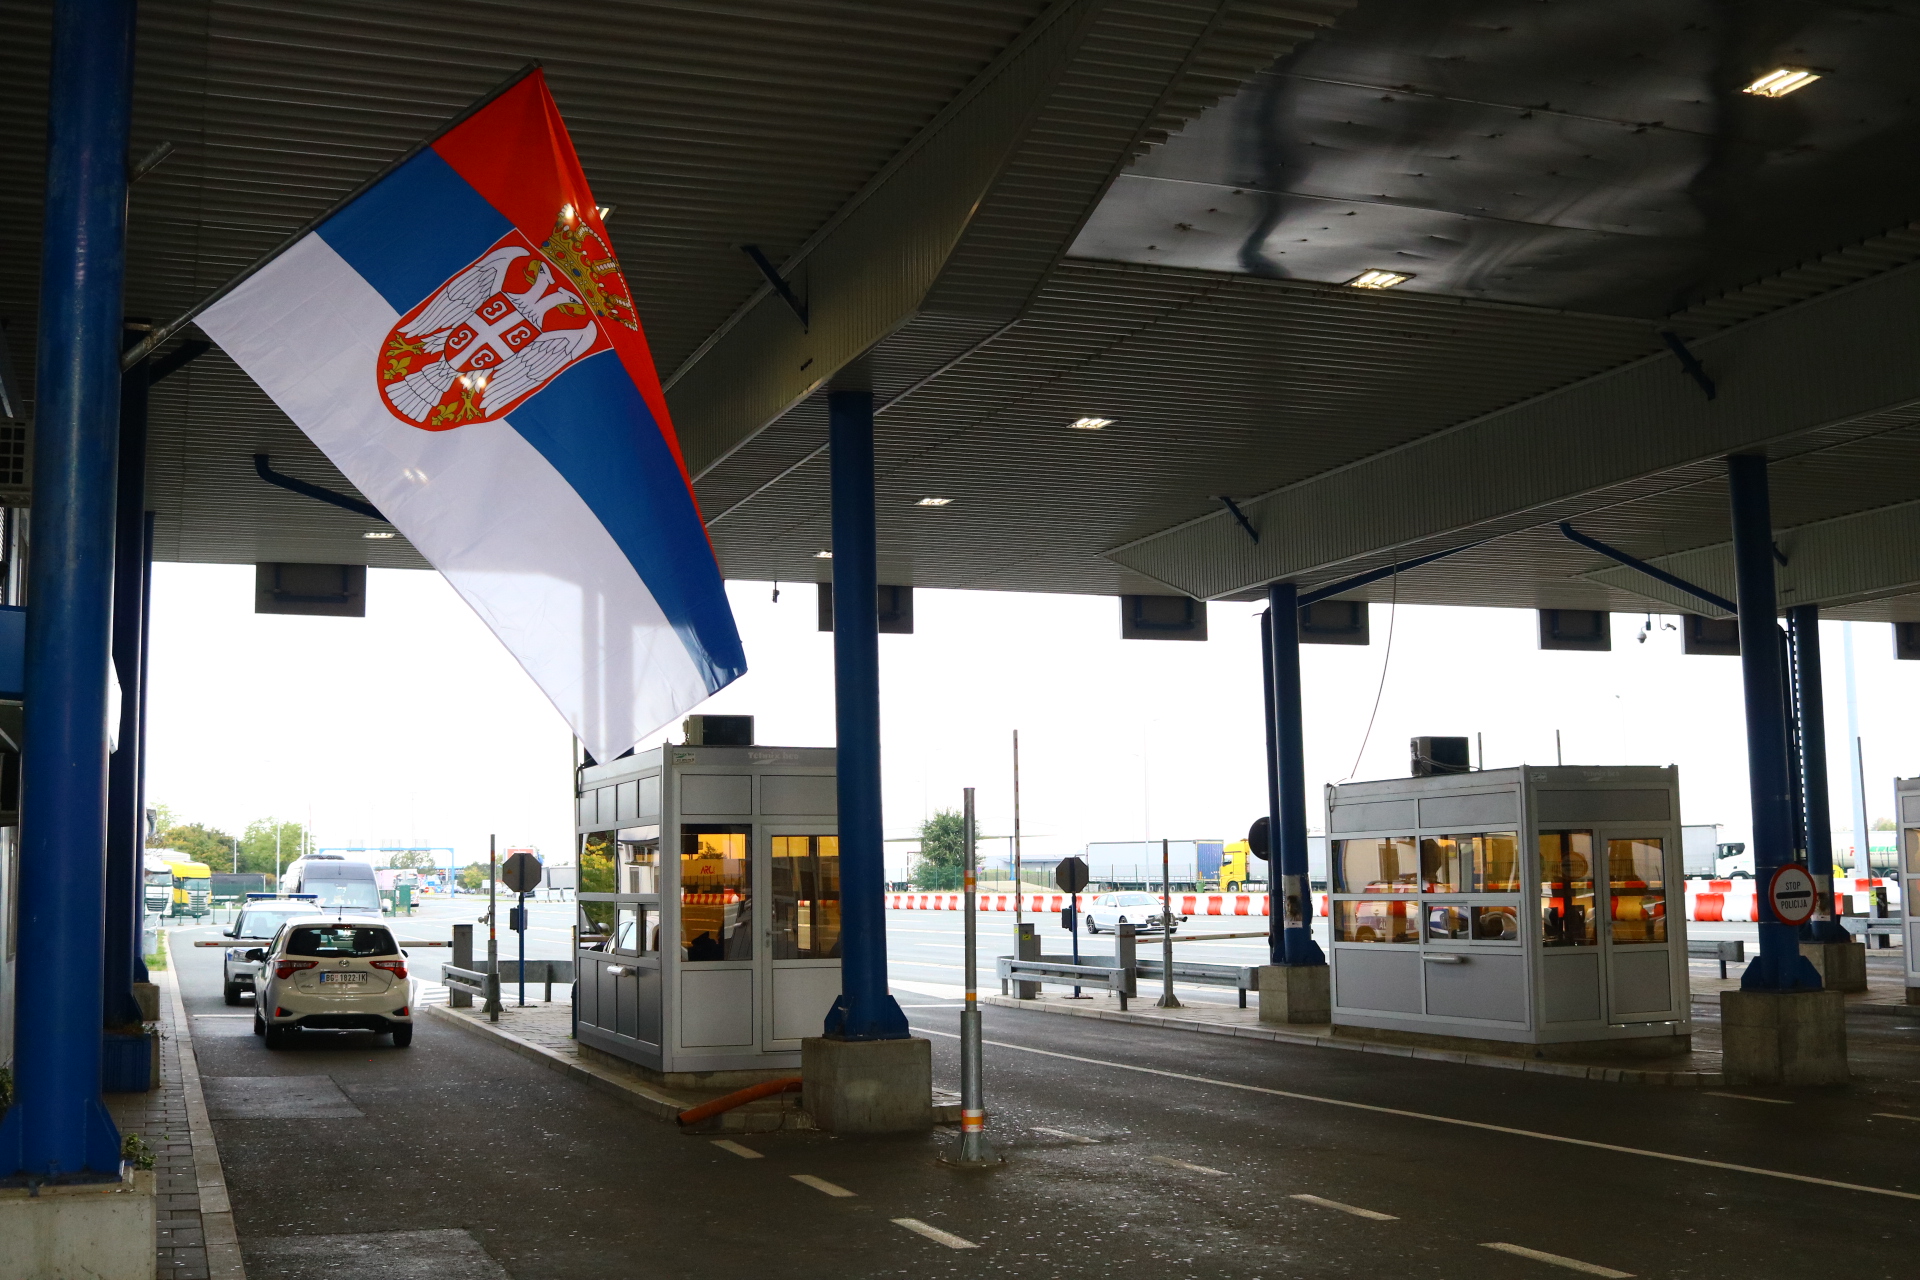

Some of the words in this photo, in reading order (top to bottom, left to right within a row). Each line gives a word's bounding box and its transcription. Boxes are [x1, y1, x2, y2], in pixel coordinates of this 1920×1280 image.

[1785, 881, 1801, 891] STOP
[1780, 899, 1808, 909] POLICIJA
[325, 974, 335, 982] BG
[340, 973, 366, 982] 1822-IK
